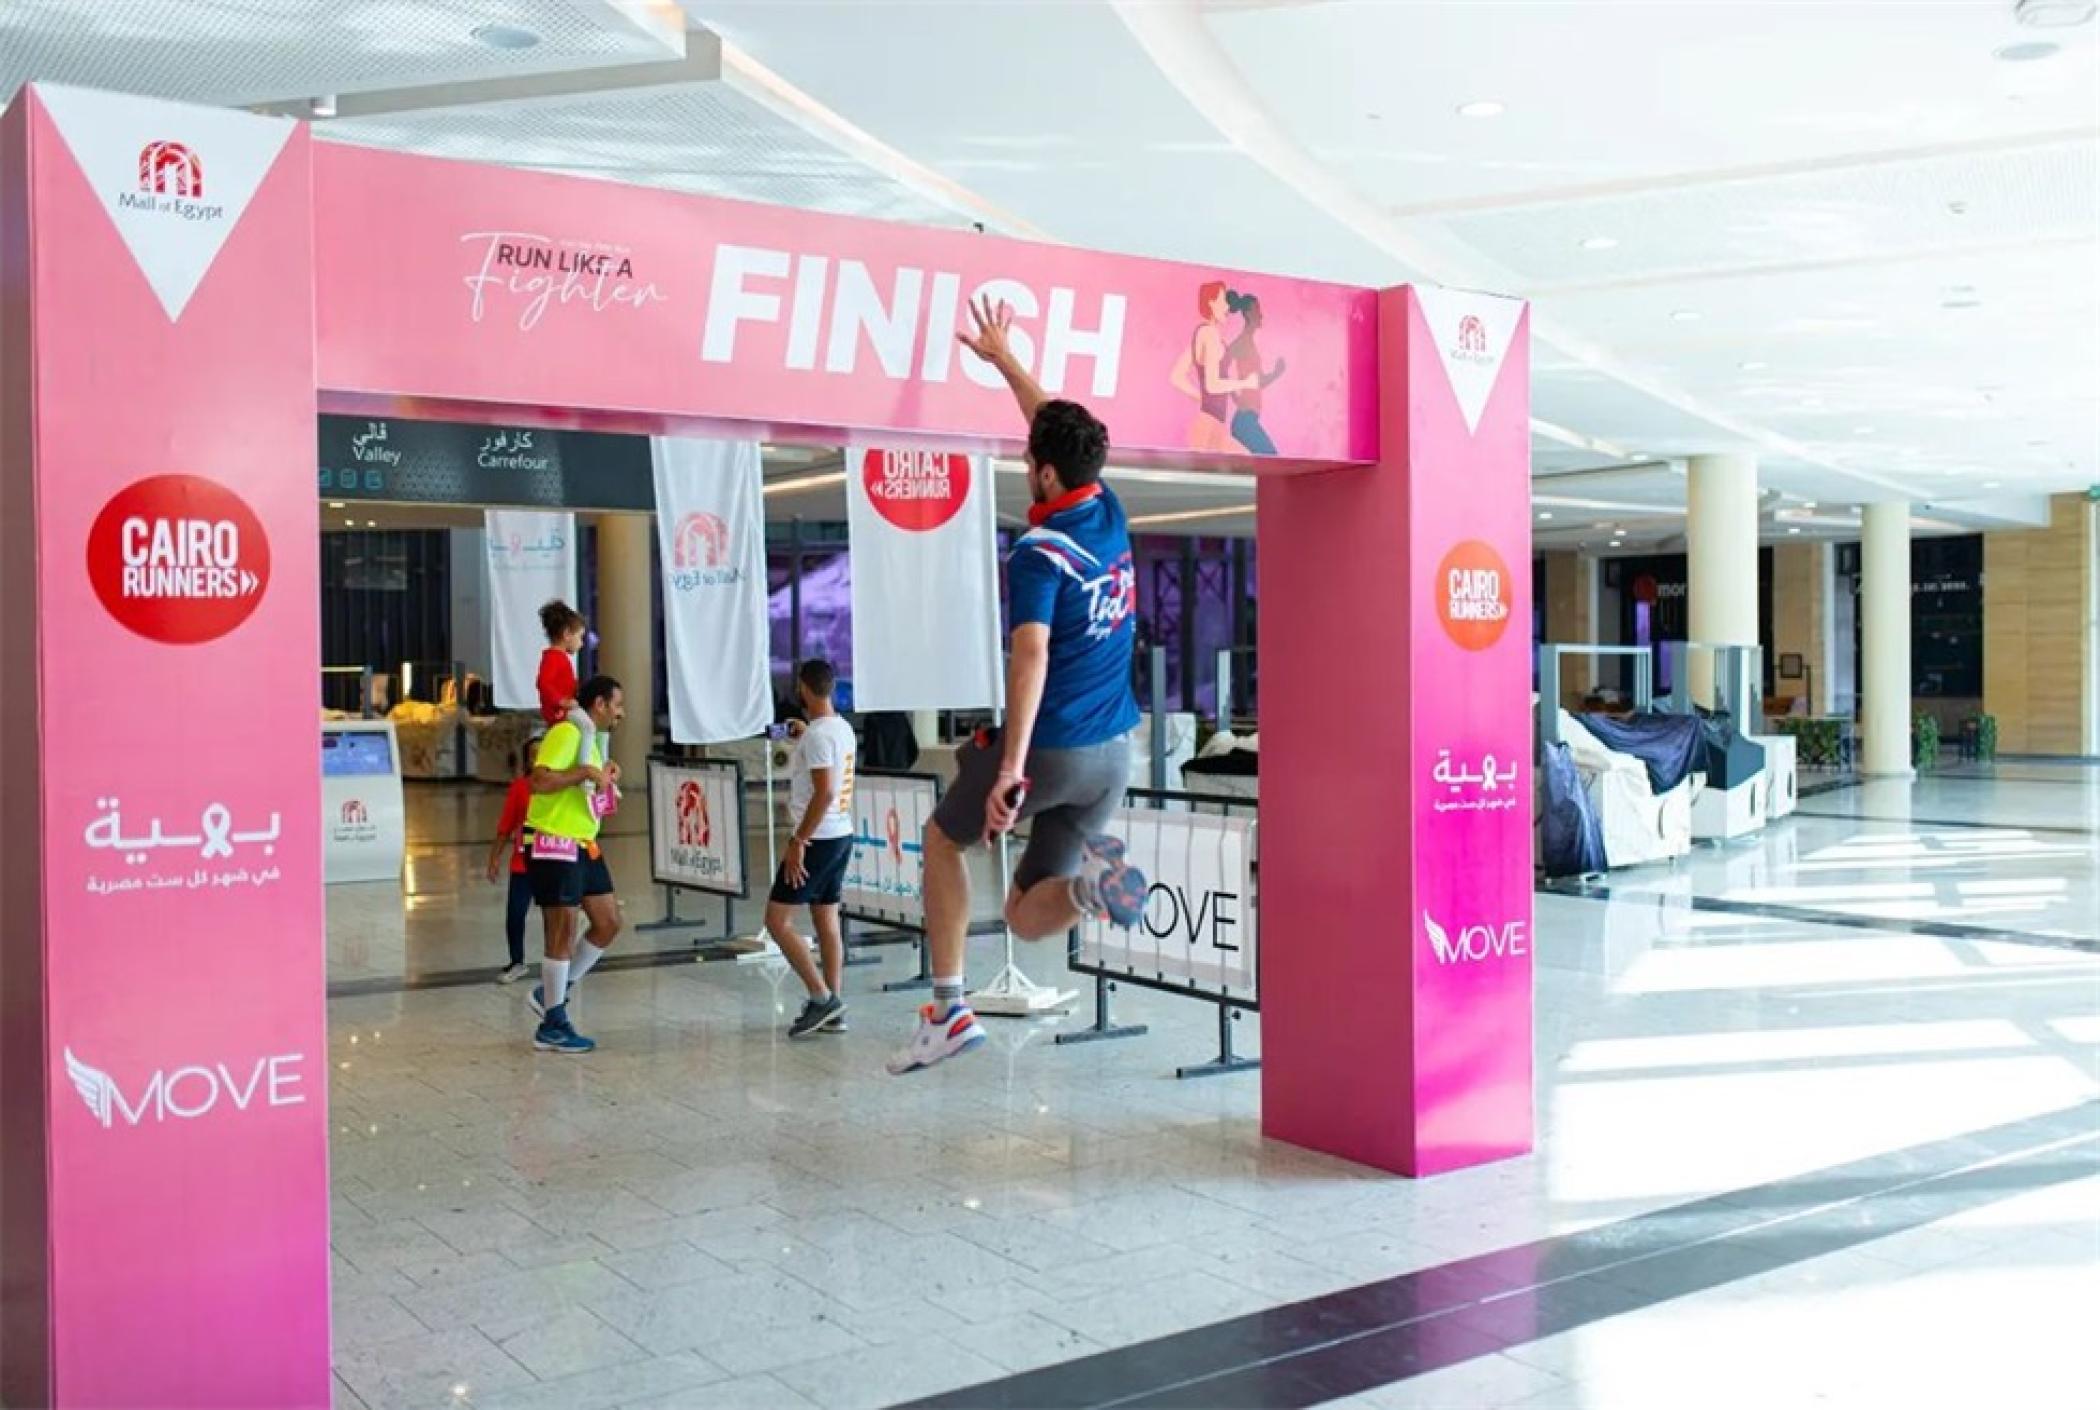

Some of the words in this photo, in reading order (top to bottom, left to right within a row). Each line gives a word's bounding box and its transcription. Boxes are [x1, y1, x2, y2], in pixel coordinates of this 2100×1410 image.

[119, 192, 156, 210] Mall
[175, 198, 224, 221] Egypt
[498, 243, 552, 270] RUN
[559, 252, 610, 277] LIKE
[617, 258, 634, 278] A
[702, 243, 1128, 398] FINISH
[352, 446, 402, 467] Valley
[477, 453, 549, 470] Carrefour
[121, 516, 239, 568] CAIRO
[122, 566, 239, 598] RUNNERS
[1447, 568, 1500, 599] CAIRO
[1448, 599, 1500, 620] RUNNERS
[1433, 749, 1518, 793] بهية
[85, 797, 281, 865] بهية
[86, 875, 144, 895] مصرية
[147, 873, 183, 889] ست
[187, 868, 208, 888] كل
[251, 865, 281, 887] في
[1138, 882, 1240, 951] OVE
[1439, 921, 1528, 965] MOVE
[100, 1053, 306, 1129] MOVE
